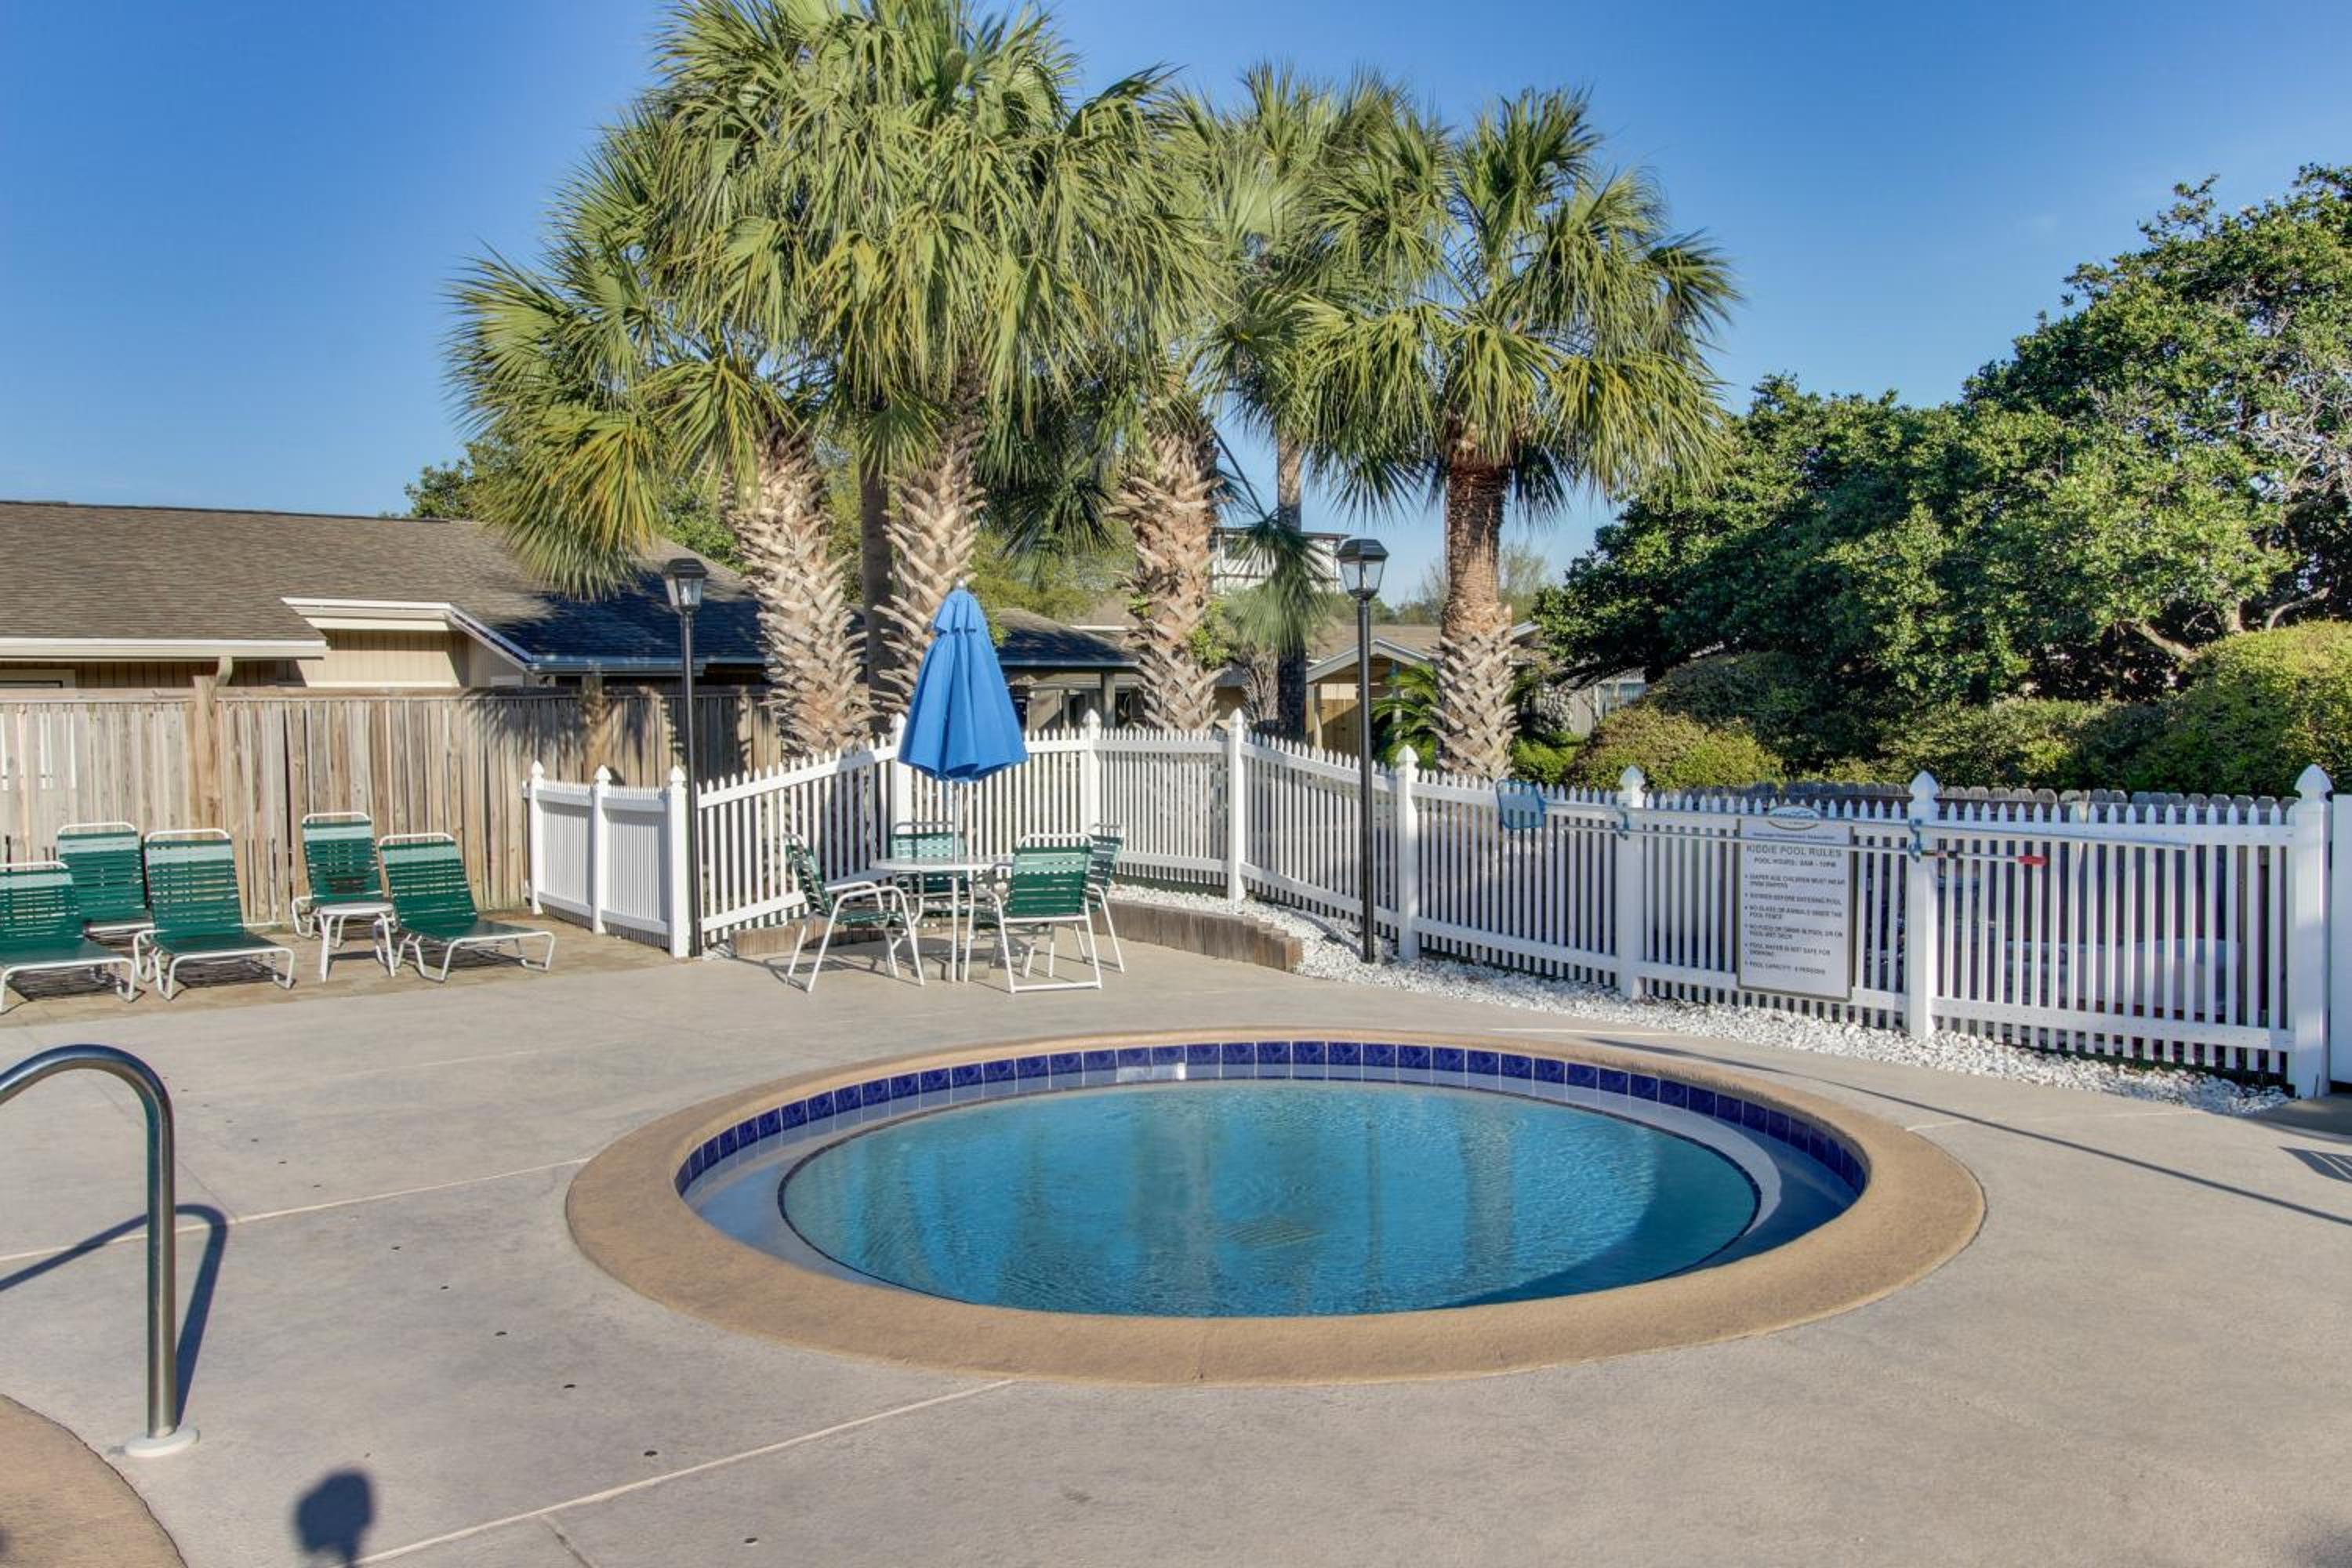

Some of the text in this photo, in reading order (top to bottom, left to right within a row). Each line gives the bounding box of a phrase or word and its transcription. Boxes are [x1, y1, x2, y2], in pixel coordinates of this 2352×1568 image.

[1746, 844, 1842, 857] KIDDIE POOL RULES
